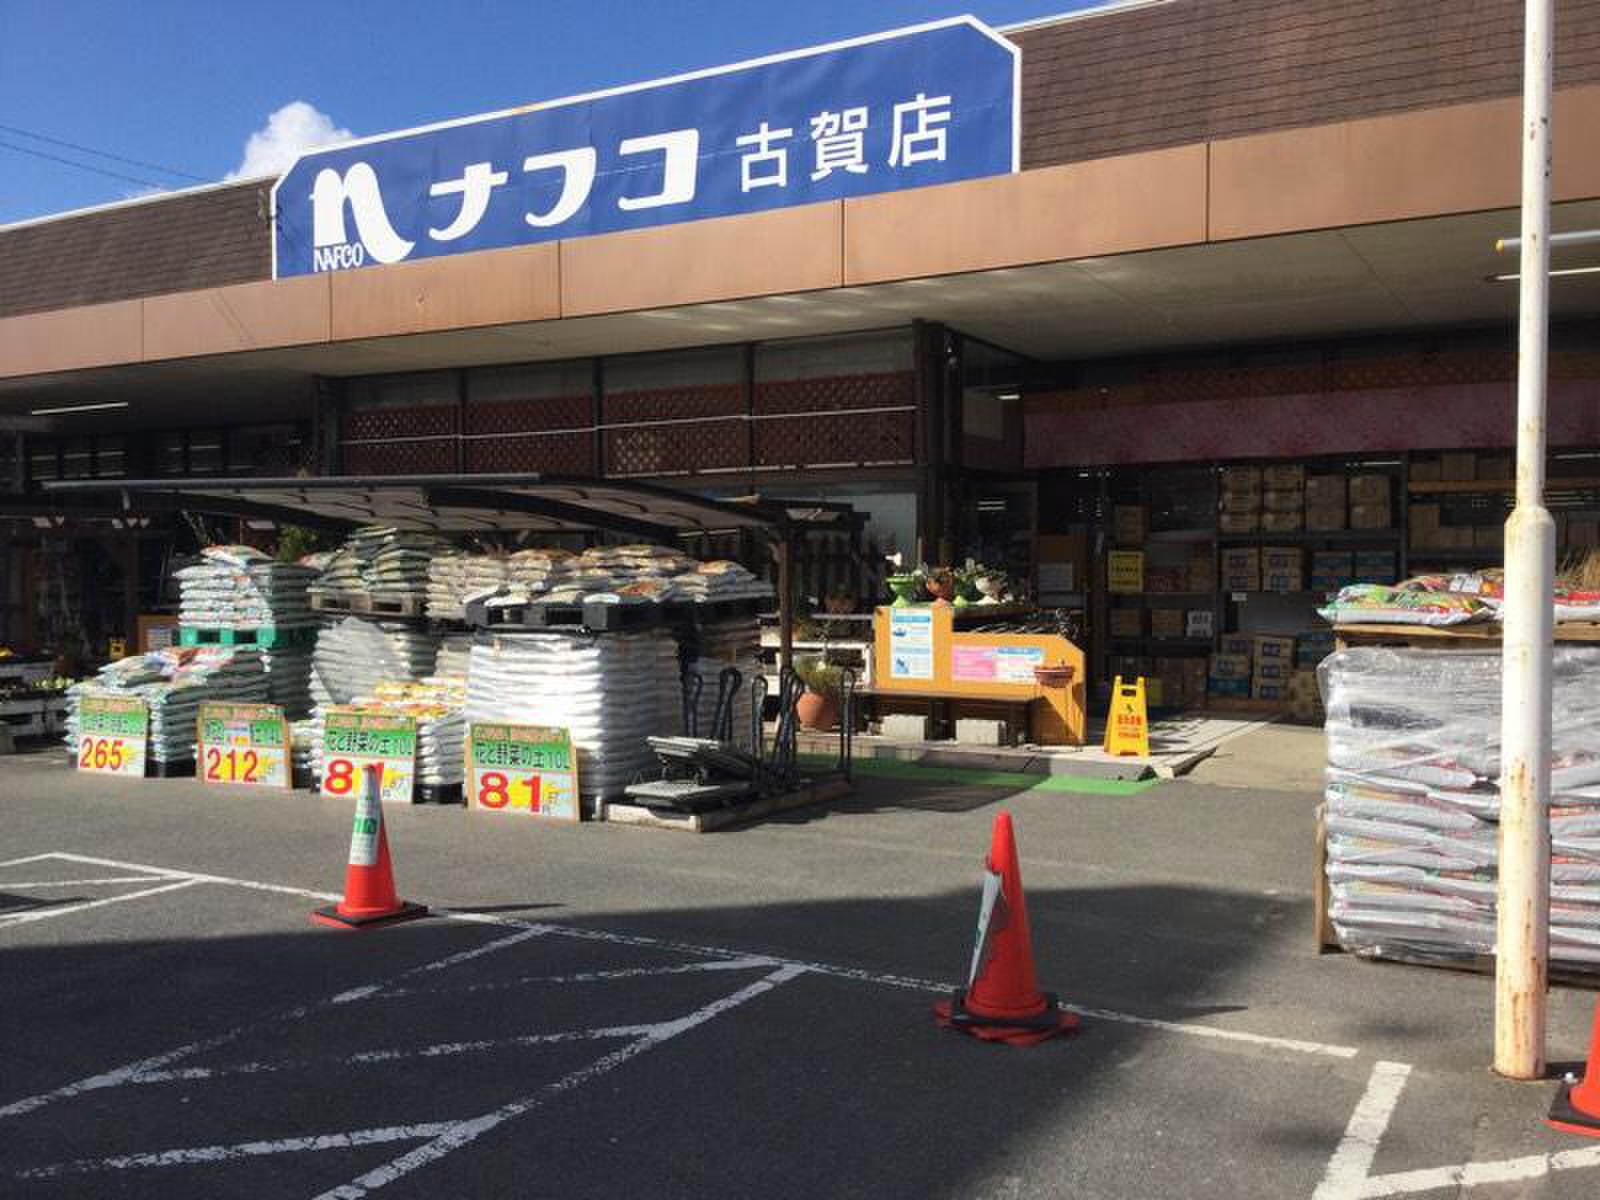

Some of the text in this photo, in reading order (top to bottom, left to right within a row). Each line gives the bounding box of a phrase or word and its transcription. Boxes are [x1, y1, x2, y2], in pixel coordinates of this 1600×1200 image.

[428, 93, 953, 242] ナフコ 古賀店
[314, 242, 364, 273] NAFCO
[80, 737, 123, 770] 265
[207, 747, 258, 782] 212
[480, 771, 541, 813] 81
